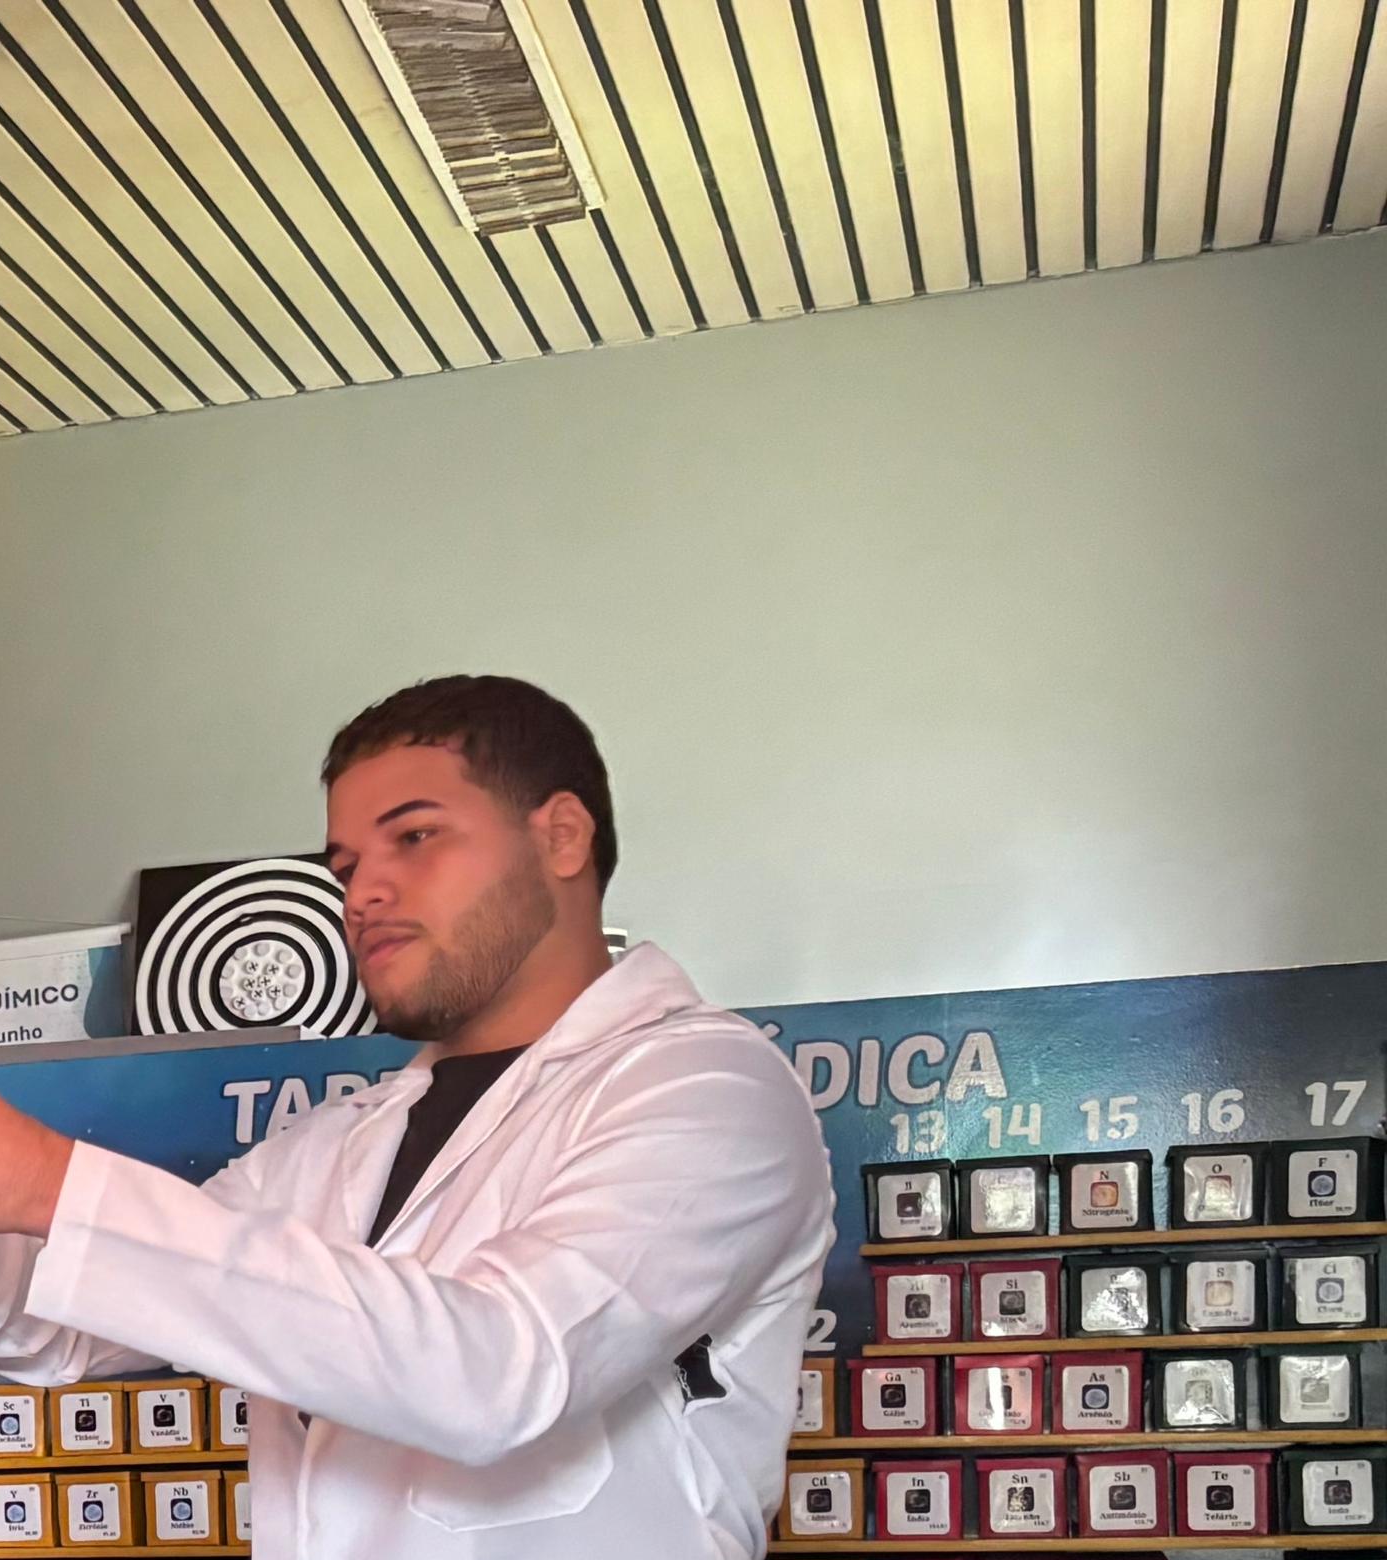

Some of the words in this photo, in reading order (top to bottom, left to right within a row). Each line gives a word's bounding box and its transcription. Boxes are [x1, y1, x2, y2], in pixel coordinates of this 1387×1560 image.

[890, 1110, 946, 1154] 13
[983, 1103, 1041, 1149] 14
[1079, 1096, 1139, 1142] 15
[1181, 1089, 1245, 1135] 16
[1305, 1080, 1367, 1127] 17
[1318, 1158, 1327, 1167] F
[1212, 1164, 1222, 1174] O
[1100, 1171, 1109, 1180] N
[1006, 1279, 1018, 1289] Si
[805, 1309, 837, 1351] 2
[885, 1372, 901, 1382] Ga
[1089, 1372, 1105, 1382] As
[158, 1394, 166, 1403] V
[3, 1402, 14, 1410] Sc
[1012, 1474, 1027, 1484] Sn
[1115, 1472, 1129, 1482] Sb
[1212, 1471, 1228, 1480] Te
[811, 1477, 827, 1486] Cd
[912, 1478, 925, 1487] In
[87, 1490, 99, 1499] Zr
[174, 1487, 188, 1496] Nb
